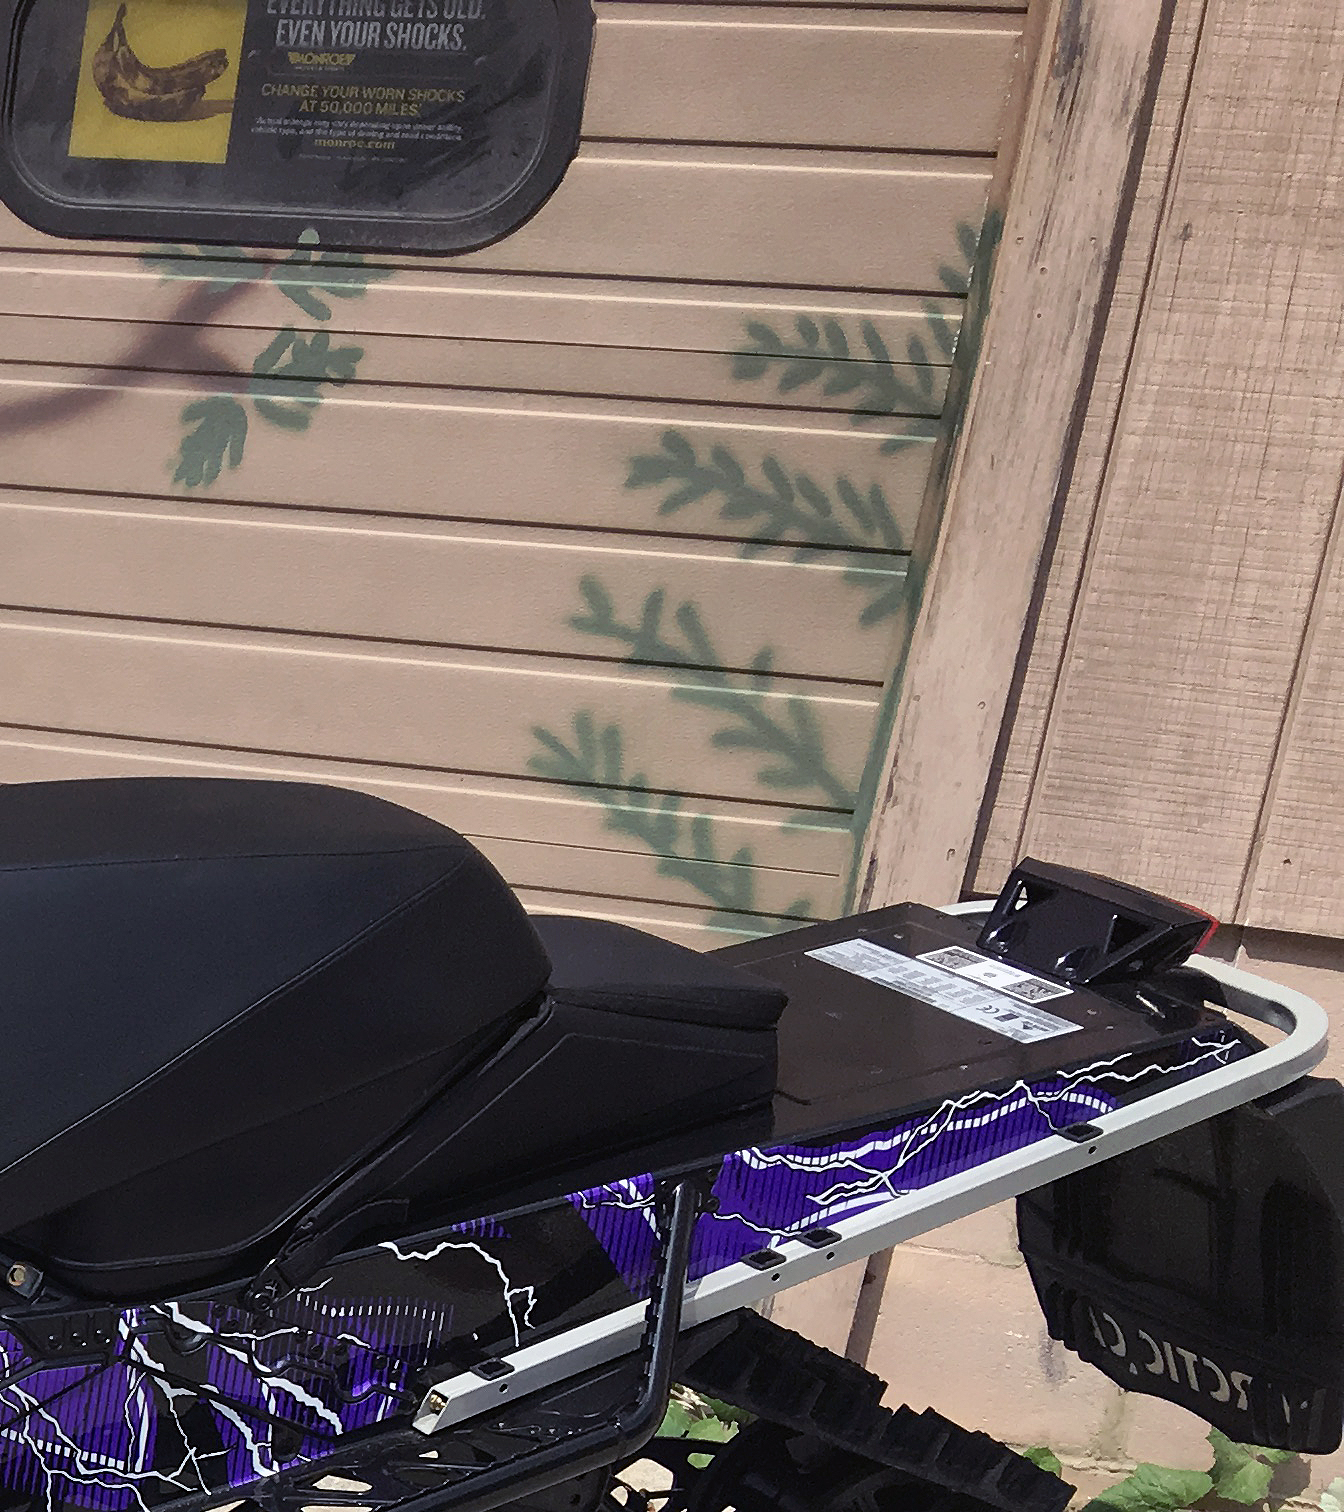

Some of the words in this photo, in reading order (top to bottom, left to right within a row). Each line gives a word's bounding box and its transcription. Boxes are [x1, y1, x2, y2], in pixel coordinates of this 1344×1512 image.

[275, 18, 326, 48] EVEN
[330, 20, 381, 49] YOUR
[384, 21, 467, 51] SHOCKS.
[262, 83, 317, 98] CHANGE
[321, 85, 360, 99] YOUR
[362, 87, 405, 101] WORN
[408, 89, 465, 103] SHOCKS
[299, 99, 317, 113] AT
[320, 101, 373, 115] 50,000
